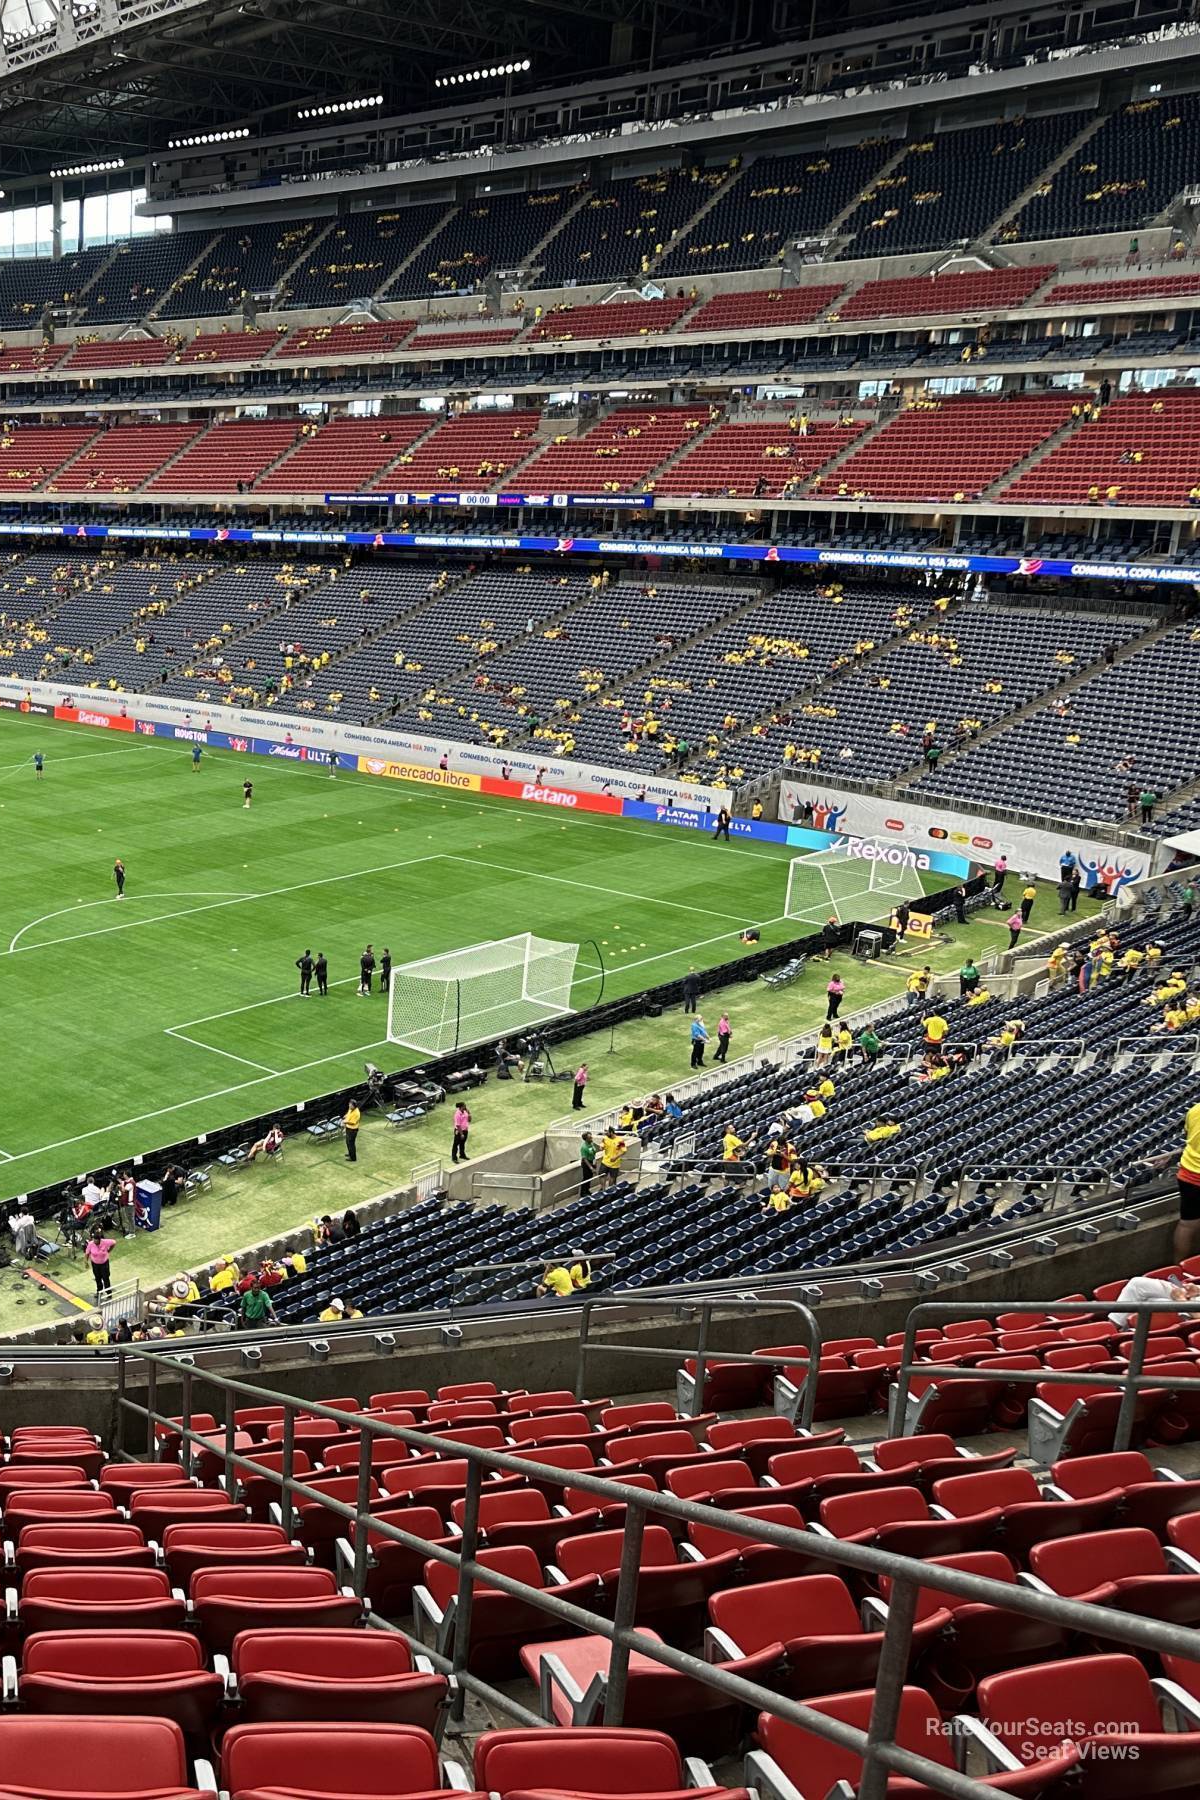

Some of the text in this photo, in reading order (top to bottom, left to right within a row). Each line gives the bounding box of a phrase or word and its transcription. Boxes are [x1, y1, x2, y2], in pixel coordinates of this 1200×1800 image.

[1071, 564, 1128, 577] CONMEBOL
[1129, 566, 1157, 578] COPA
[78, 711, 109, 727] Betano
[174, 728, 208, 743] HOUSTON
[459, 751, 492, 764] CONMEBOL
[509, 760, 536, 771] AMERICA
[549, 766, 565, 776] 2024
[389, 764, 470, 787] mercado libre
[521, 783, 577, 806] Betano
[591, 775, 627, 789] CONMEBOL
[646, 785, 678, 798] AMERICA
[679, 792, 693, 801] USA
[694, 794, 711, 804] 2024
[665, 817, 699, 828] AIRLINES
[666, 809, 699, 821] LATAM
[729, 824, 752, 832] ELTA
[846, 836, 930, 870] Rexona
